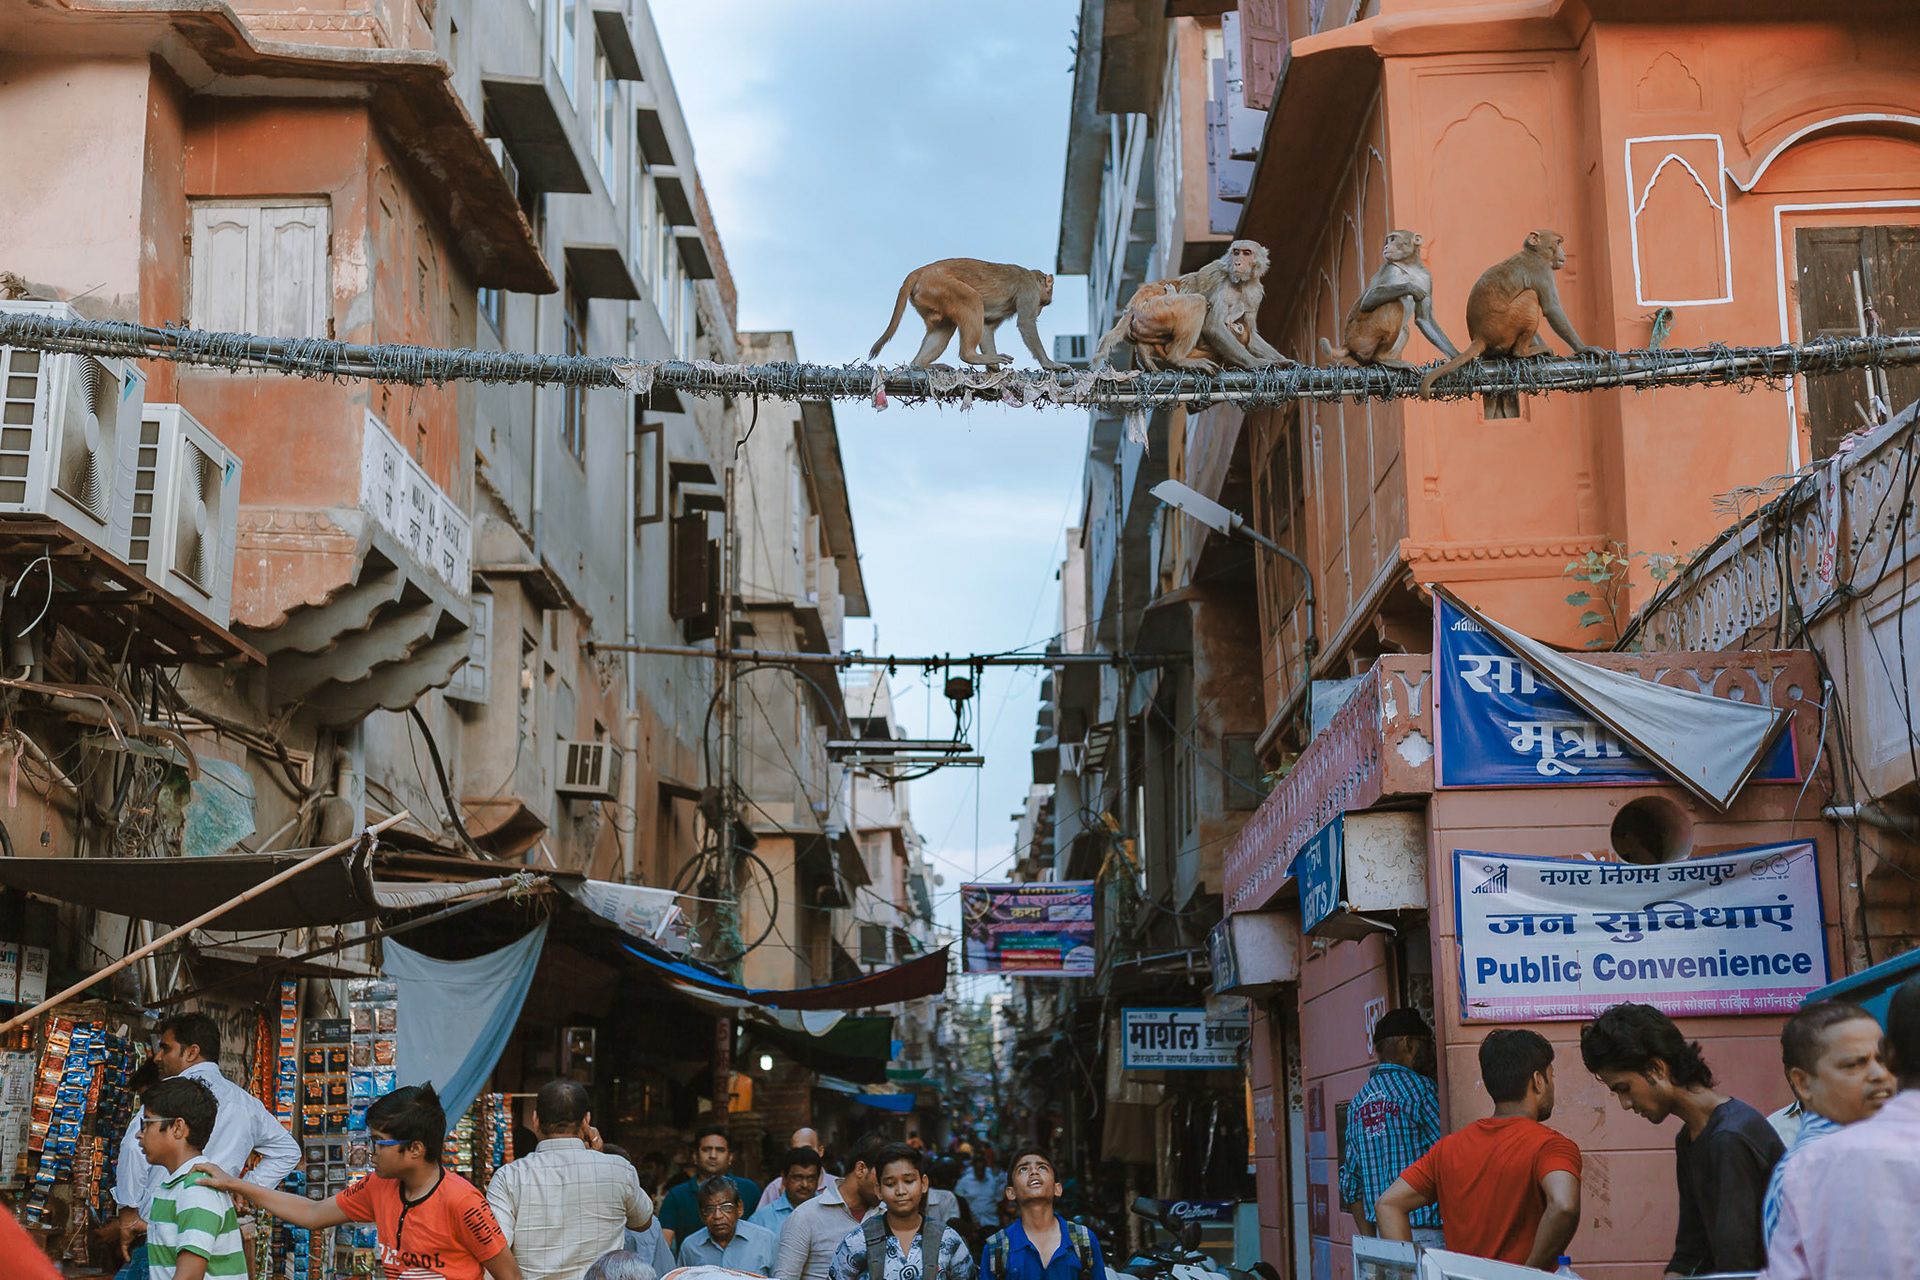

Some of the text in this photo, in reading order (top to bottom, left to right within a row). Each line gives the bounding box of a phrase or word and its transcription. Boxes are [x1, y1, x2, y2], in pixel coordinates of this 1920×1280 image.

[383, 452, 395, 482] GHI
[412, 483, 426, 515] WALO
[1508, 721, 1630, 776] मूत्रा
[1540, 862, 1737, 886] नगर निगम जयपुर
[1304, 881, 1328, 929] GENTS
[1485, 893, 1795, 944] जन सुविधाएं
[1476, 948, 1813, 985] Public Convenience
[1516, 1001, 1531, 1018] एवं
[1533, 1003, 1579, 1016] रखरखाव
[1589, 1002, 1612, 1016] सुल
[1683, 995, 1717, 1011] सोशल
[1719, 994, 1751, 1009] सर्विस
[1128, 1012, 1201, 1050] मार्शल
[1217, 1055, 1229, 1064] पर
[401, 1252, 445, 1269] COOL
